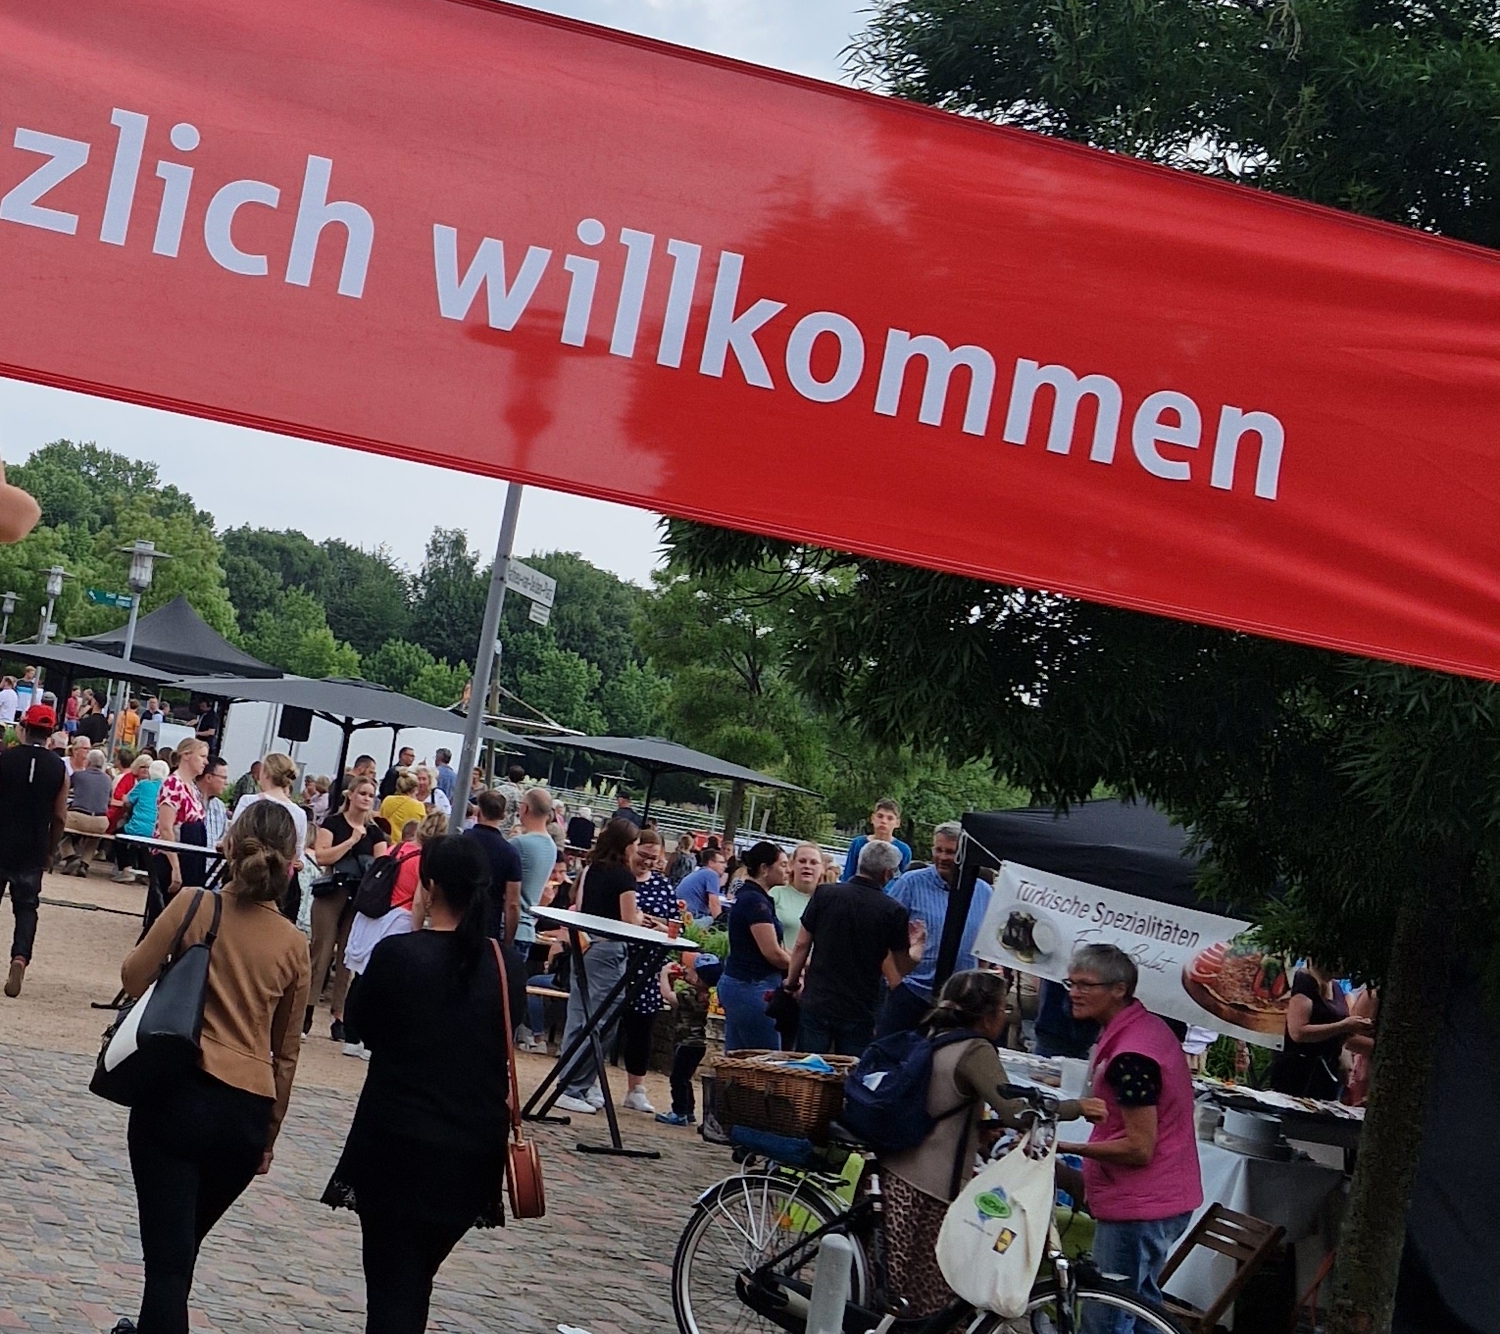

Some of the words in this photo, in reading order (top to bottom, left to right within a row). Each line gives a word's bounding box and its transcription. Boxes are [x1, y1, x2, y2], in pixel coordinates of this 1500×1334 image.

[432, 218, 1288, 502] willkommen
[1015, 879, 1091, 919] Türkische
[1091, 901, 1200, 949] Spezialitäten
